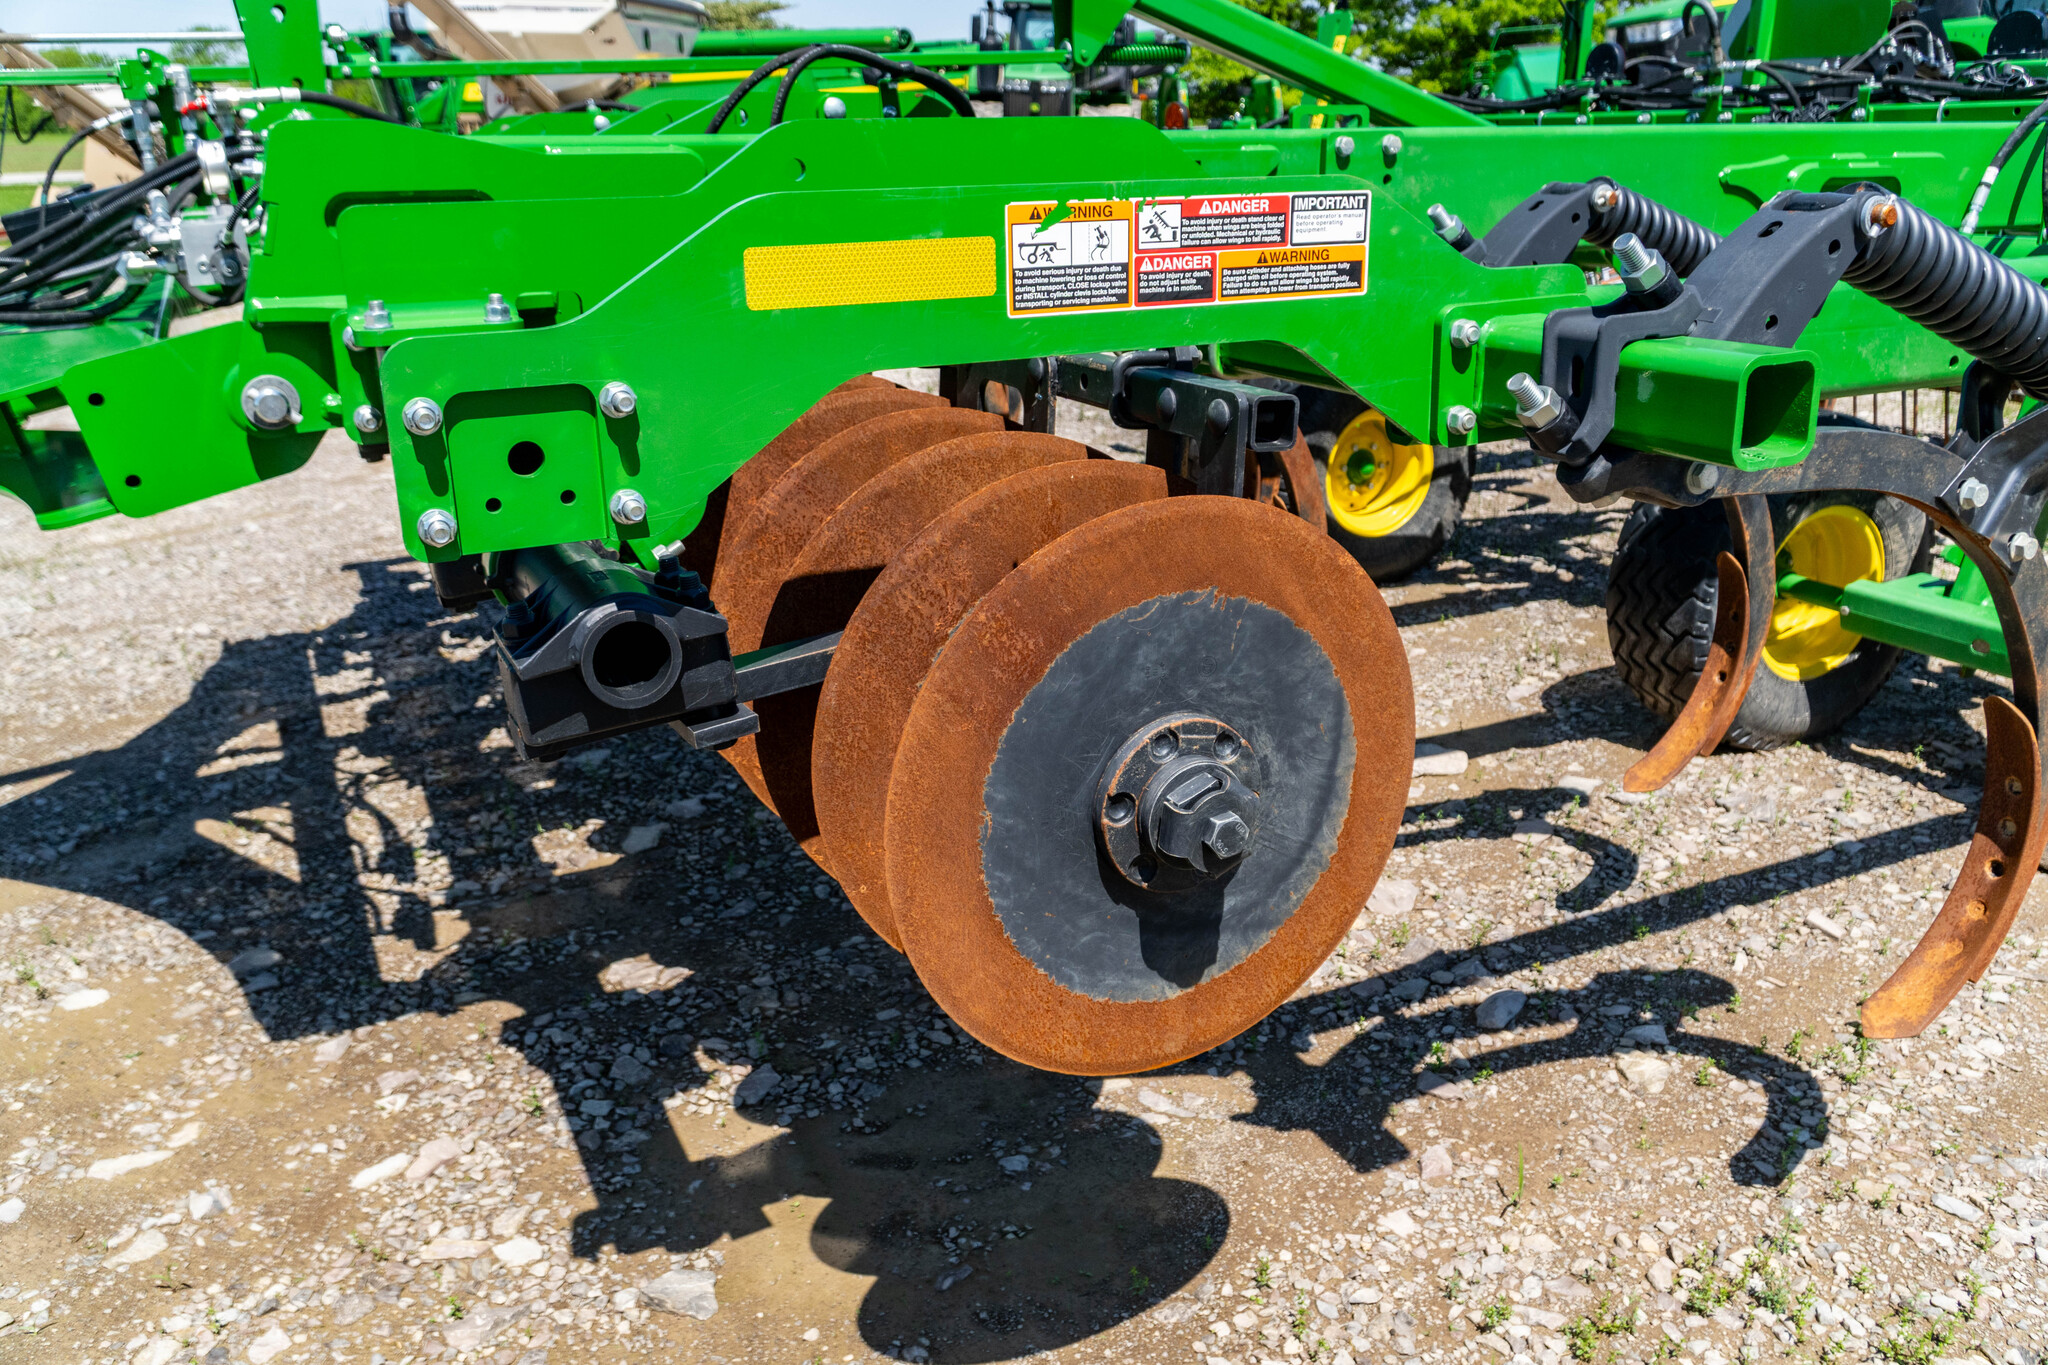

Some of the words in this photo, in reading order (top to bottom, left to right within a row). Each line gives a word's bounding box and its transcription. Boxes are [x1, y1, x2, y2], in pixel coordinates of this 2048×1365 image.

[1212, 199, 1269, 214] DANGER
[1295, 196, 1366, 210] IMPORTANT
[1153, 256, 1211, 270] DANGER
[1270, 249, 1329, 263] WARNING
[1050, 290, 1073, 299] cylinder
[1240, 286, 1270, 294] attempting
